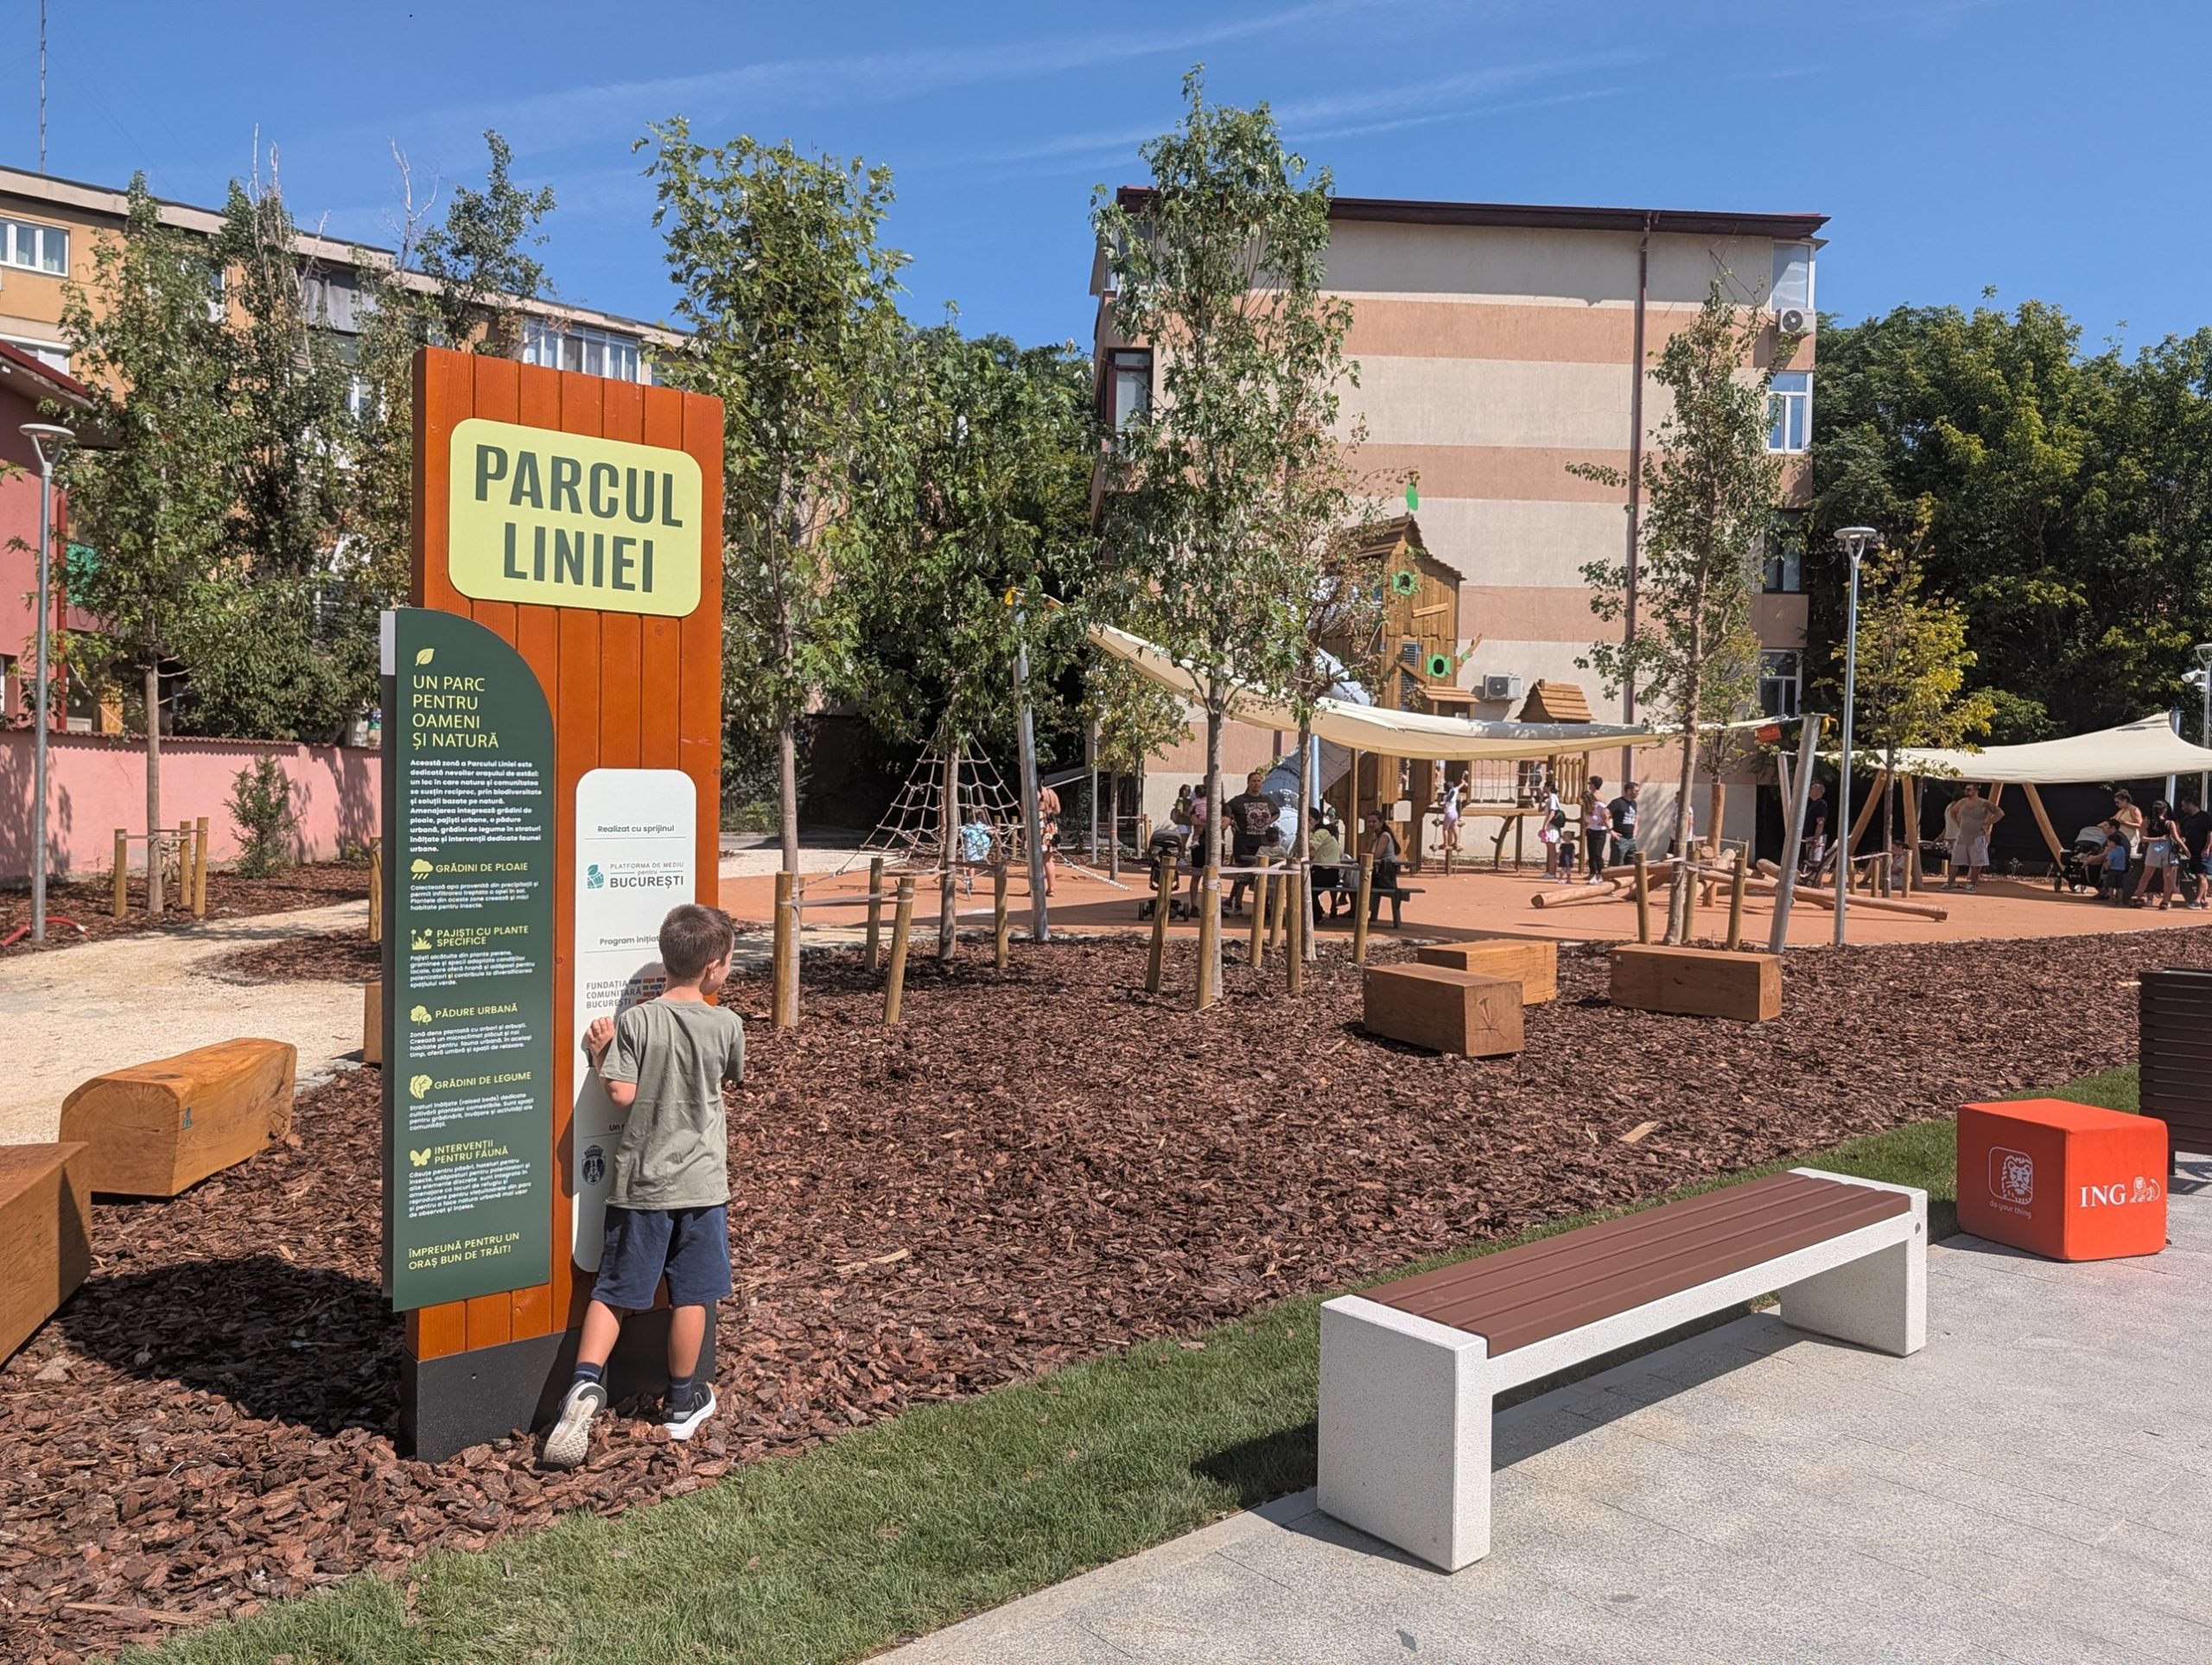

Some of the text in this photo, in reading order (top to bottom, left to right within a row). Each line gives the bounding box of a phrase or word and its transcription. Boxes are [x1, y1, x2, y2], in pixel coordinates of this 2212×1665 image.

[475, 444, 683, 527] PARCUL
[504, 522, 654, 593] LINIEI
[414, 675, 485, 691] UN PARC
[413, 694, 478, 709] PENTRU
[412, 714, 480, 728] OAMENI
[413, 732, 499, 750] ȘI NATURĂ
[643, 825, 674, 834] sprijinul
[436, 863, 477, 873] GRĂDINI
[496, 863, 528, 871] PLOAIE
[610, 876, 683, 889] BUCUREȘTI
[437, 926, 528, 938] PAJIȘTI CU PLANTE
[437, 937, 486, 947] SPECIFICE
[600, 938, 635, 946] Program
[587, 980, 628, 989] FUNDAȚIA
[587, 986, 641, 999] COMUNITARĂ
[436, 1002, 518, 1018] PĂDURE URBANĂ
[587, 998, 630, 1009] BUCUREȘTI
[434, 1072, 532, 1090] GRĂDINI DE LEGUME
[435, 1139, 493, 1155] INTERVENȚII
[435, 1145, 508, 1165] PENTRU FAUNĂ
[2080, 1183, 2126, 1208] ING
[2015, 1207, 2031, 1219] thing
[408, 1232, 519, 1258] ÎMPREUNĂ PENTRU UN
[409, 1245, 511, 1270] ORAȘ BUN DE TRĂIT!
